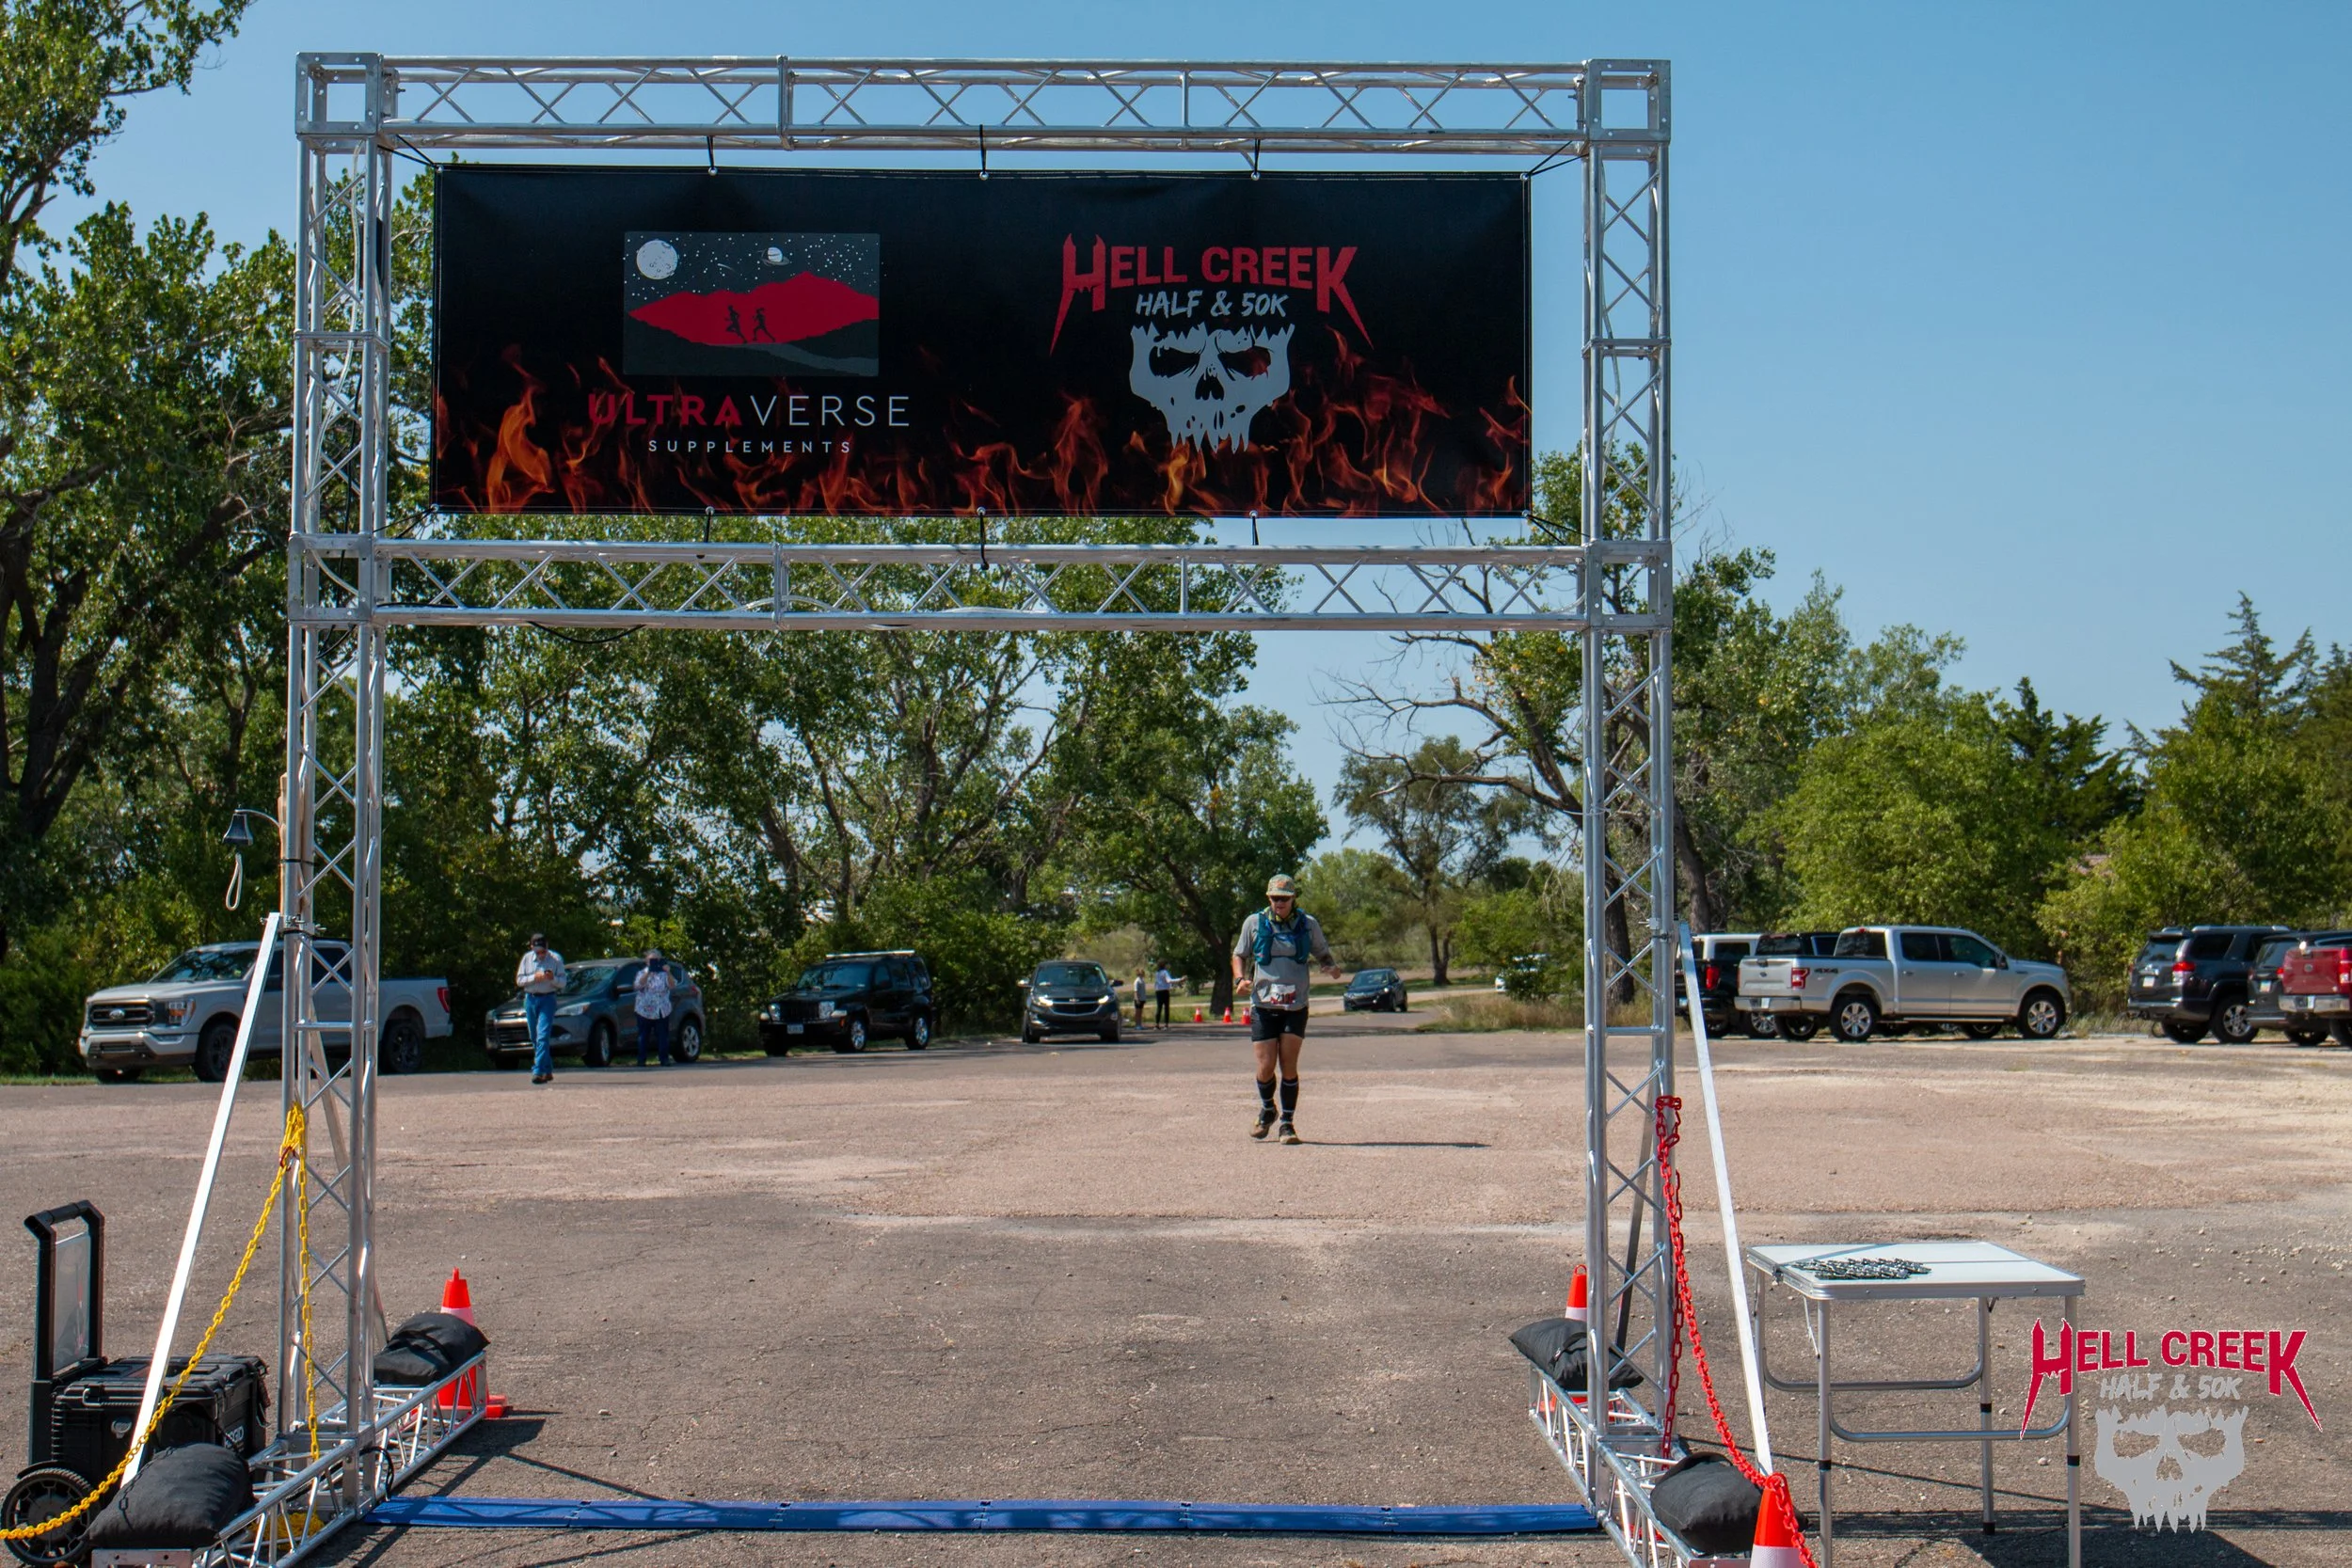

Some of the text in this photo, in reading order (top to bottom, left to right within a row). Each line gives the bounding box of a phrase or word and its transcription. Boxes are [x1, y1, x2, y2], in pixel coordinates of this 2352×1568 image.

[1050, 232, 1375, 357] HELL CREEK
[1136, 290, 1289, 318] HALF & 50K
[588, 393, 910, 426] ULTRAVERSE
[648, 439, 850, 453] SUPPLEMENTS
